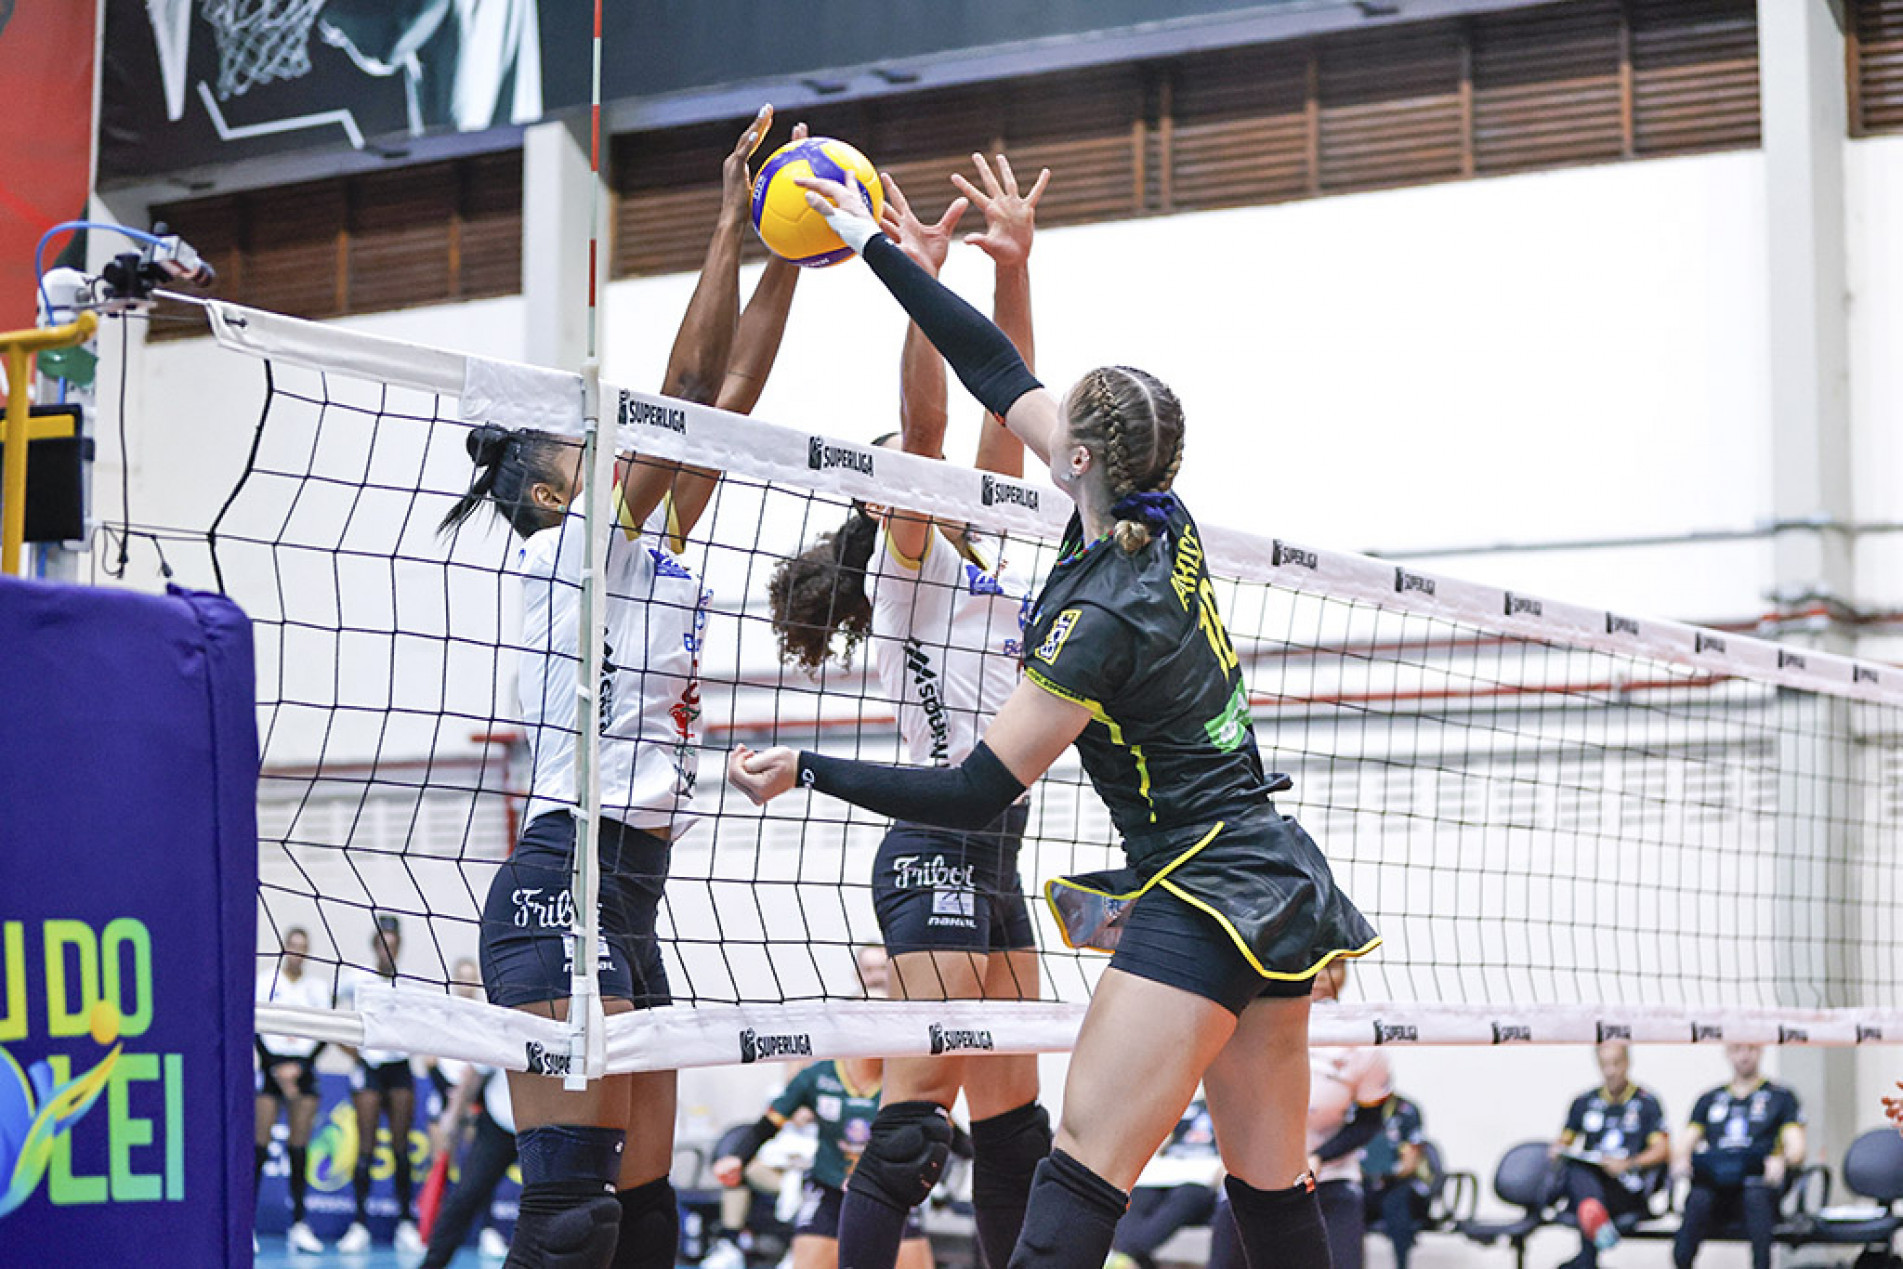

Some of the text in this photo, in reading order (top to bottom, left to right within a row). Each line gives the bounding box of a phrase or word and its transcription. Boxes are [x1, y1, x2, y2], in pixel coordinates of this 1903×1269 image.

[630, 400, 686, 435] SUPERLIGA
[823, 445, 874, 477] SUPERLIGA
[995, 482, 1040, 512] SUPERLIGA
[43, 917, 153, 1037] DO
[757, 1033, 812, 1059] SUPERLIGA
[944, 1031, 994, 1051] SUPERLIGA
